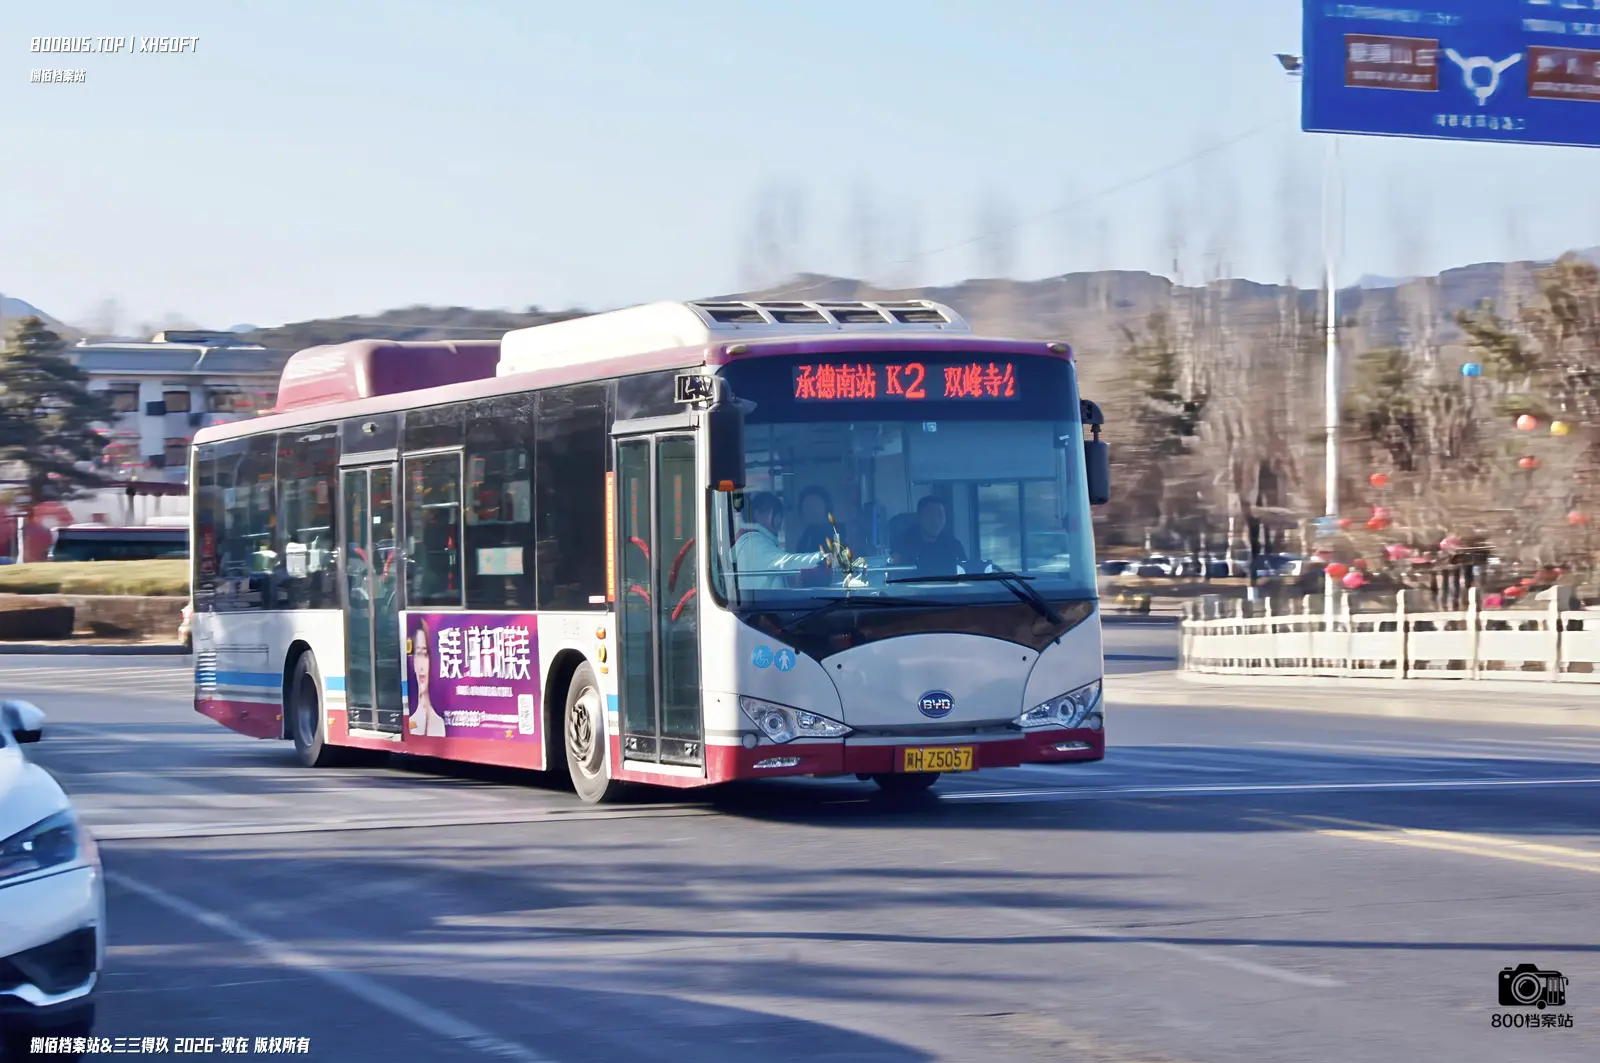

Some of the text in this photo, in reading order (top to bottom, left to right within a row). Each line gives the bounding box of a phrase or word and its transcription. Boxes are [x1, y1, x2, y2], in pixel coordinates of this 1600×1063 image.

[795, 363, 876, 399] 承德南站
[885, 362, 926, 399] K2
[923, 699, 951, 709] BYD
